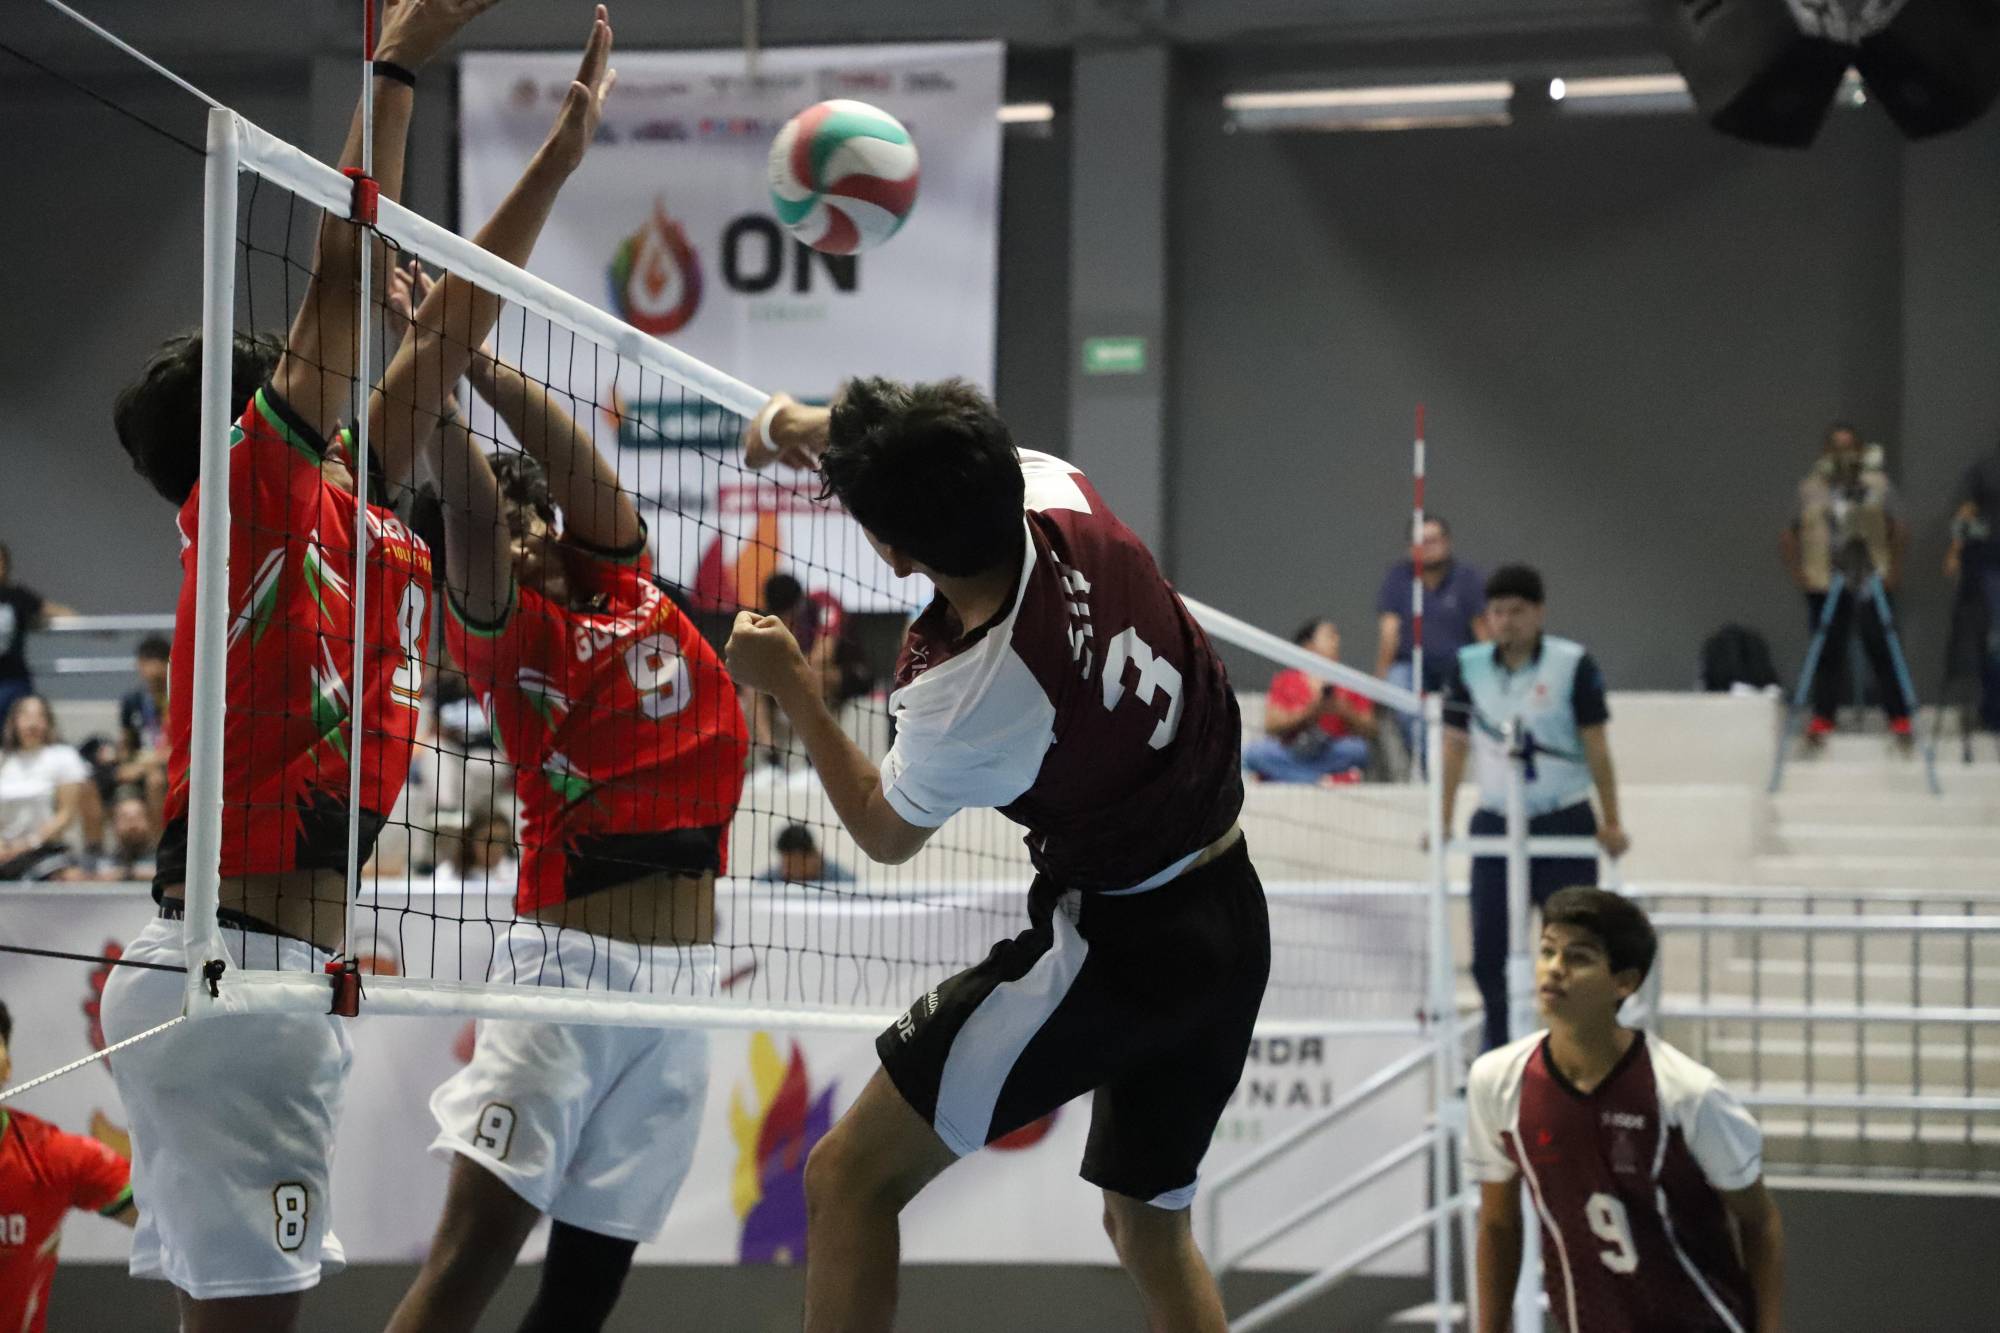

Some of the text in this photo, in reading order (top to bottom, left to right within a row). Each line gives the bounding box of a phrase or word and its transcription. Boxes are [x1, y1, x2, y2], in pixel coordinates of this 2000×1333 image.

[624, 632, 694, 721] 9
[1102, 625, 1184, 751] 3
[472, 1102, 517, 1162] 9
[273, 1182, 309, 1252] 8
[1585, 1191, 1639, 1275] 9
